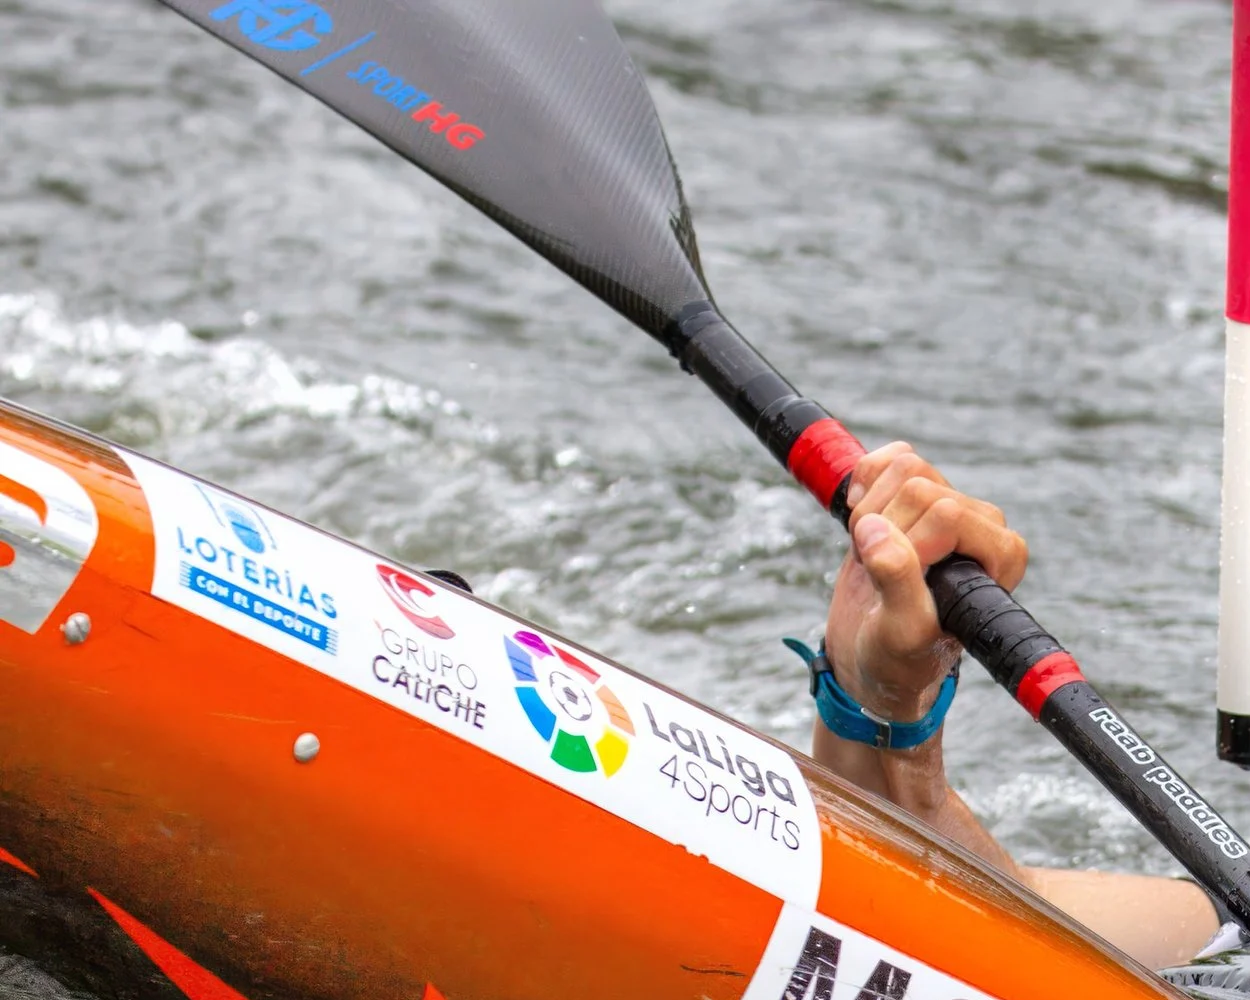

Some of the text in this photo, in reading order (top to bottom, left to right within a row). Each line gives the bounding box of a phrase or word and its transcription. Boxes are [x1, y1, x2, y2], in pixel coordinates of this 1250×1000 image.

[176, 526, 338, 619] LOTERÍAS
[196, 575, 229, 598] CON
[371, 655, 487, 730] CALICHE
[380, 627, 478, 691] GRUPO
[643, 702, 798, 807] LaLiga
[1089, 707, 1248, 859] raab paddles
[659, 754, 801, 851] 4Sports
